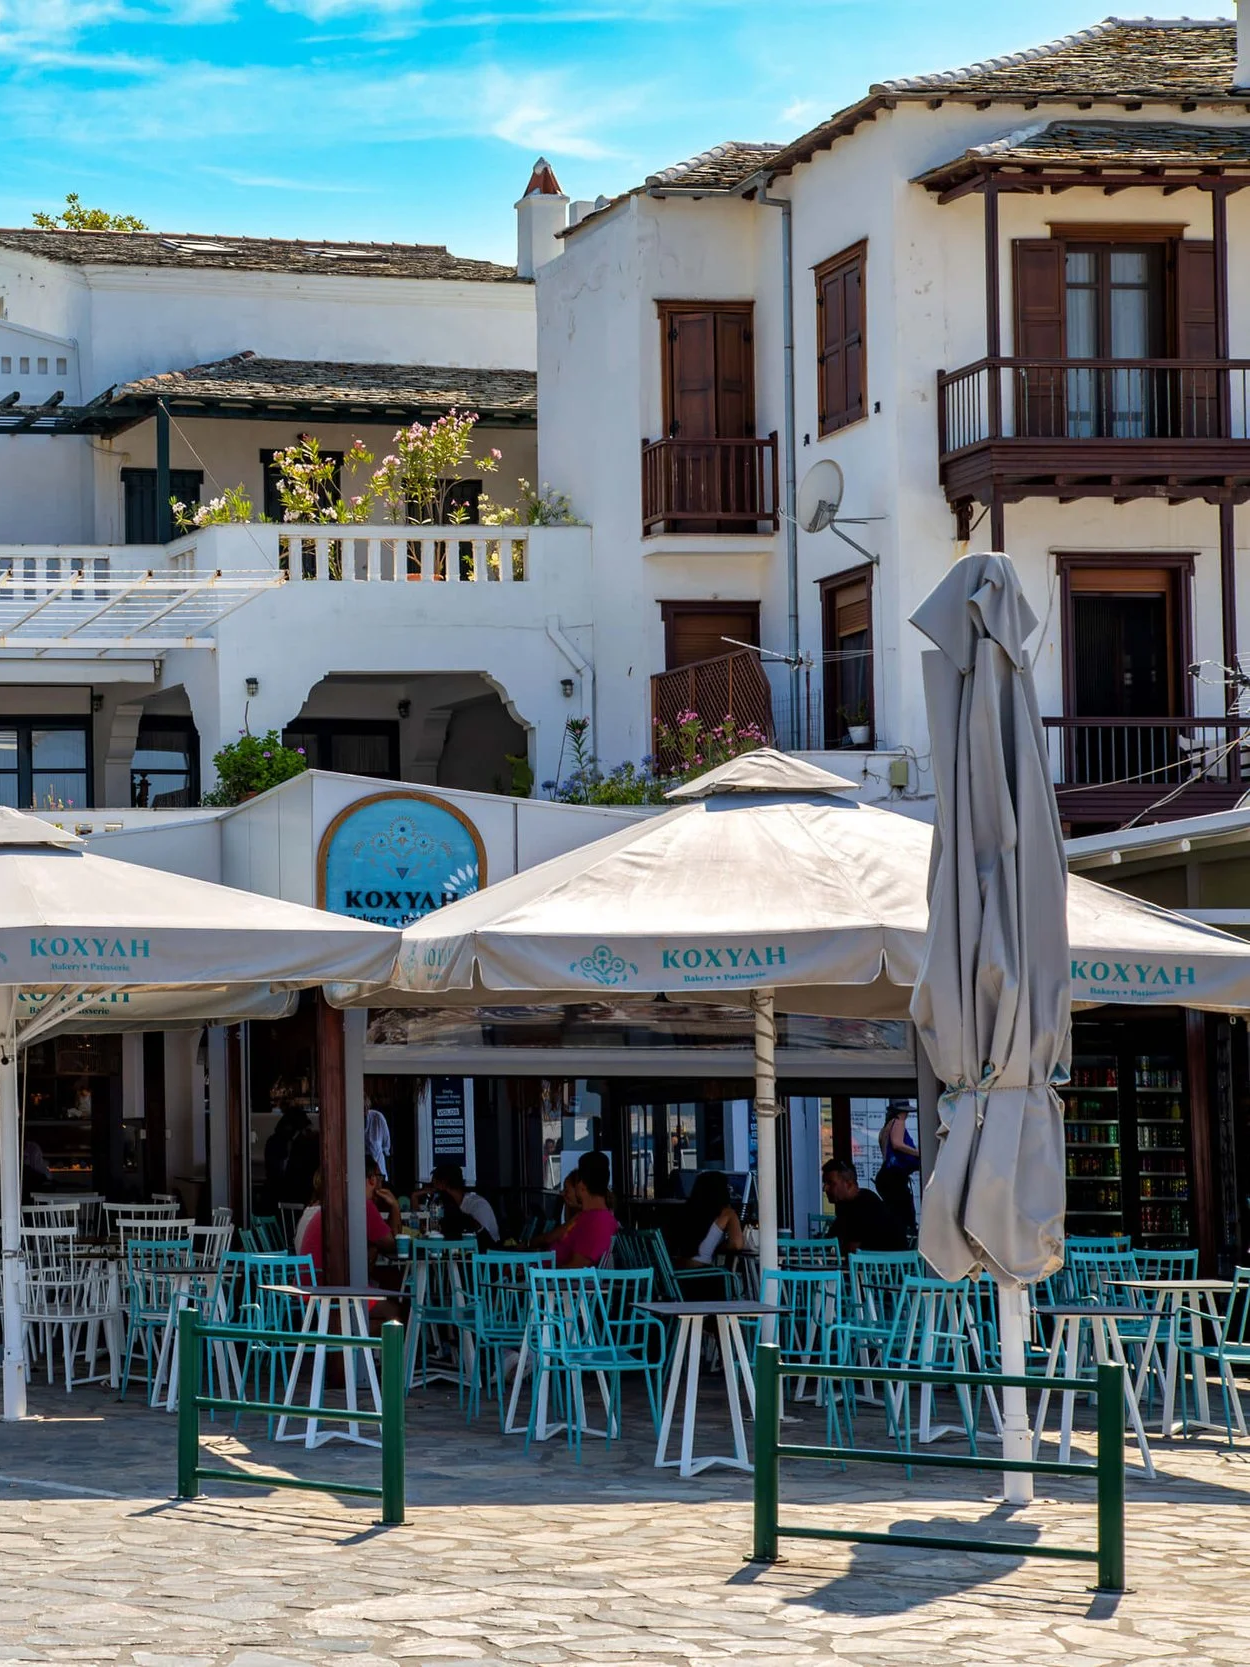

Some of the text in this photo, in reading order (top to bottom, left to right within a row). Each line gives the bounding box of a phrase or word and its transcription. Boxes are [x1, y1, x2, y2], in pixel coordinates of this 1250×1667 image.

[51, 963, 130, 971] Bakery Patisserie
[684, 974, 713, 982] Bakery
[1090, 987, 1119, 996] Bakery
